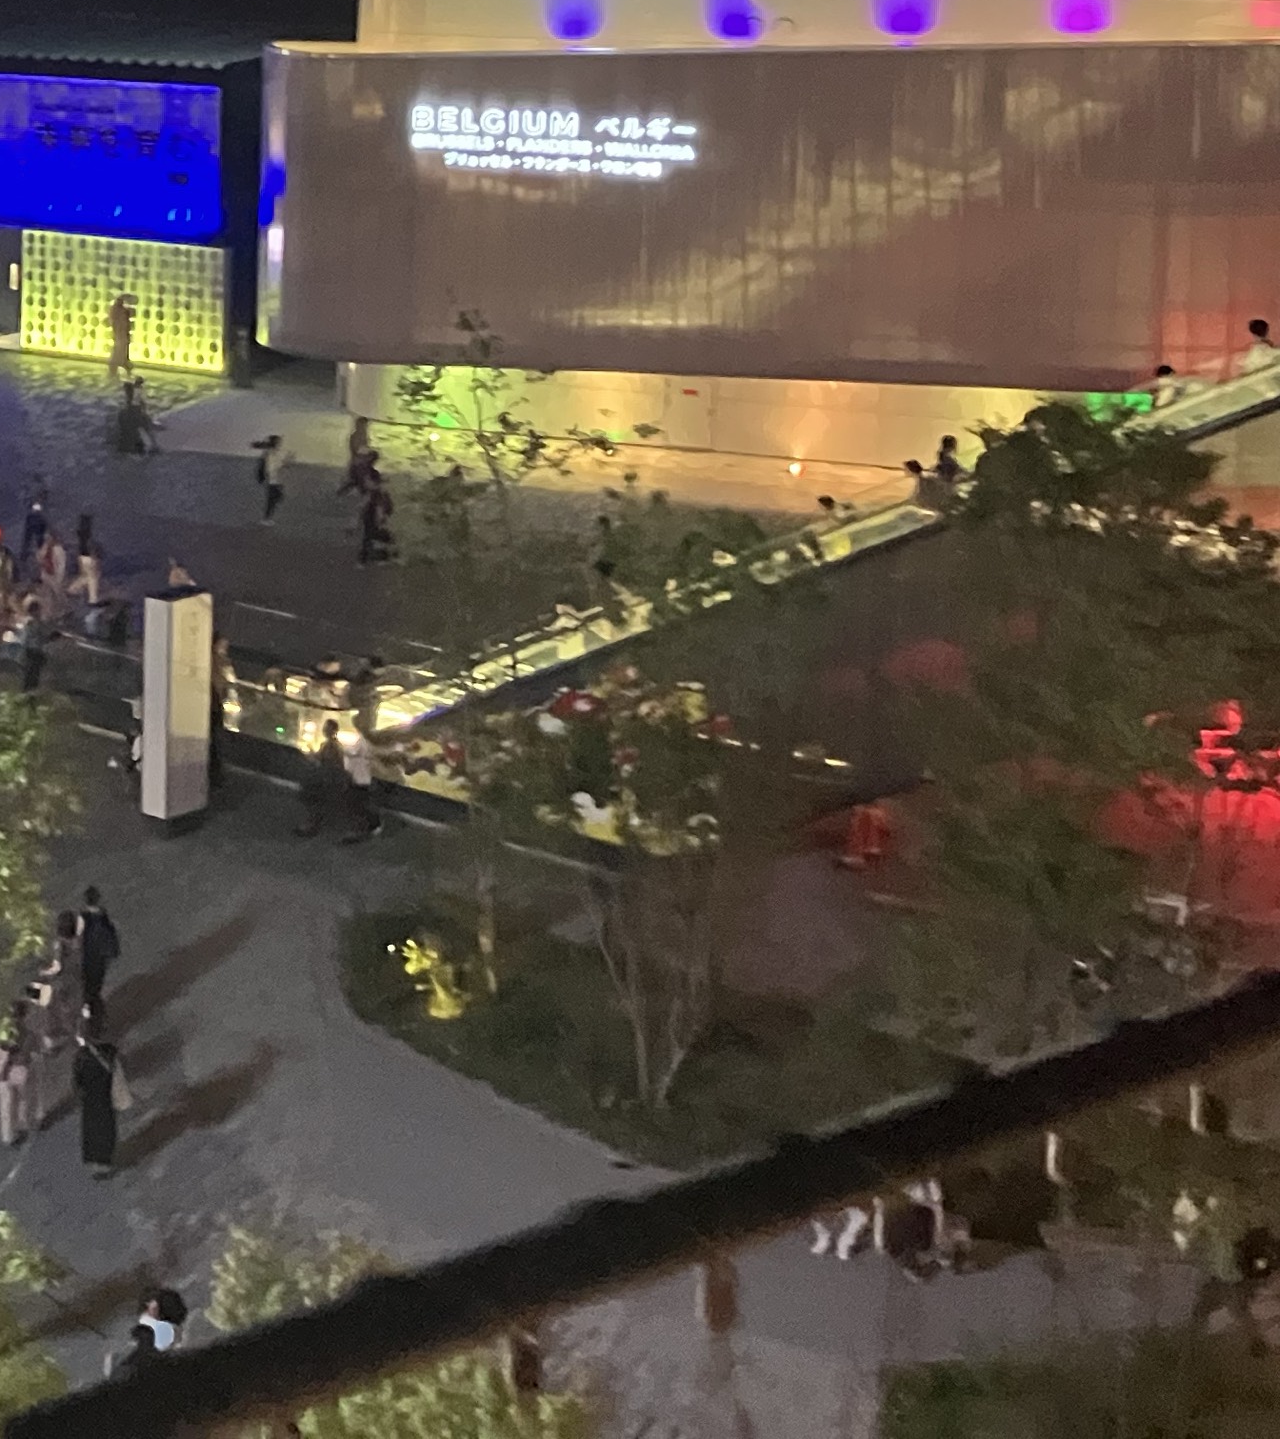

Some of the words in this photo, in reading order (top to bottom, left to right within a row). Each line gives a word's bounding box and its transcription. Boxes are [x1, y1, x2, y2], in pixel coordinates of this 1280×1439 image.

[411, 105, 579, 138] BELGIUM
[594, 117, 697, 141] ベルギー
